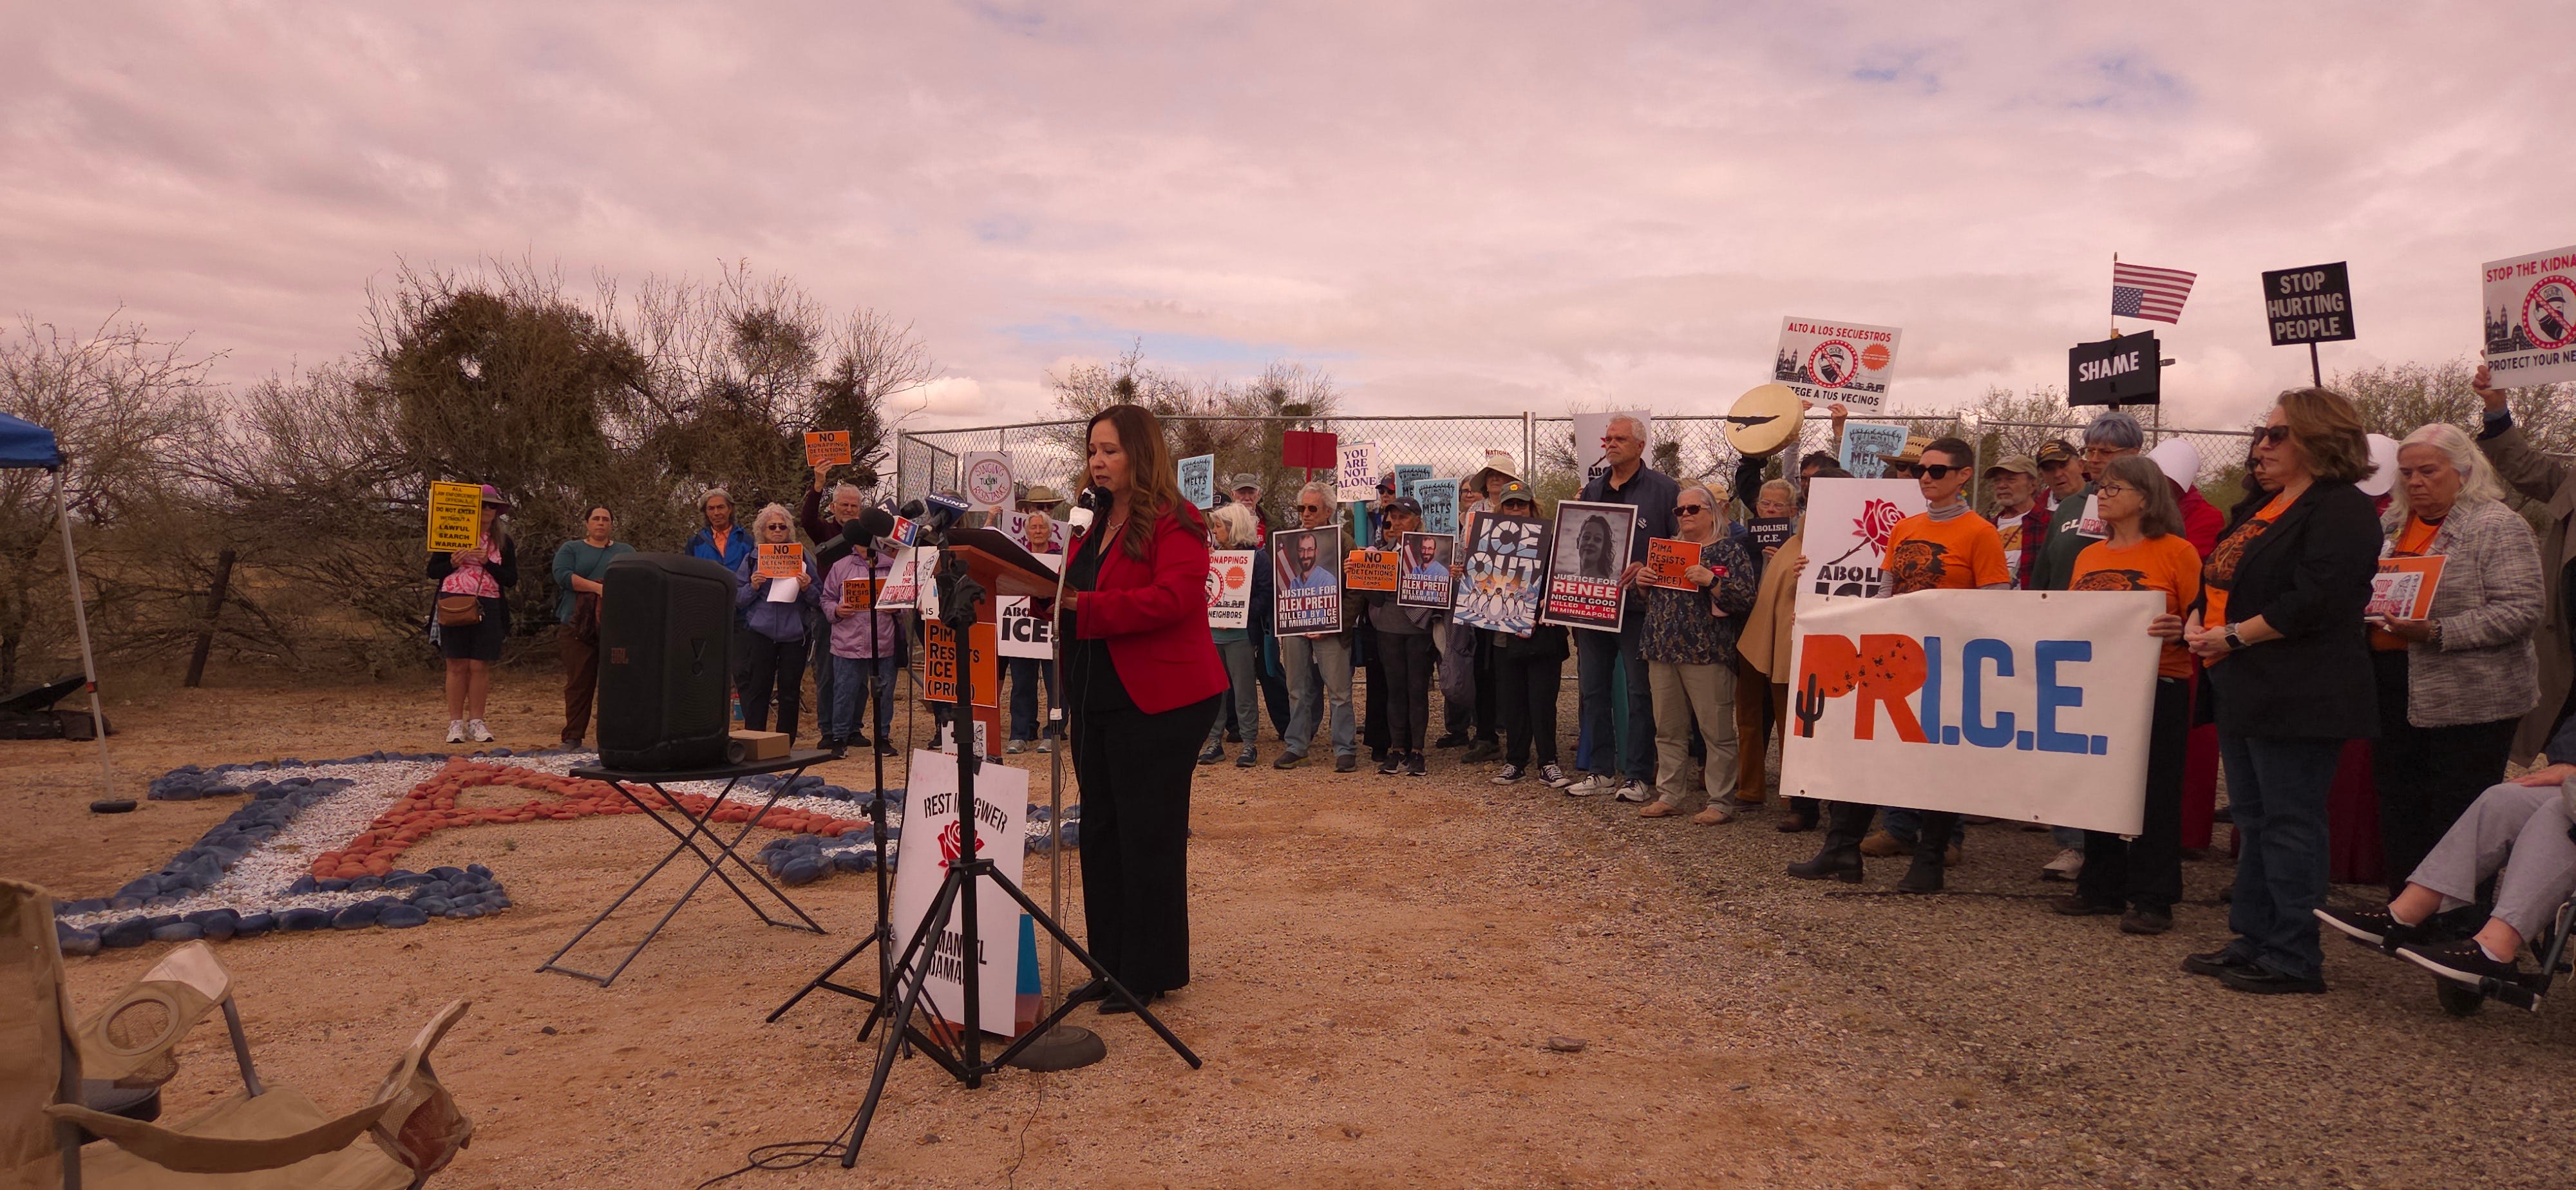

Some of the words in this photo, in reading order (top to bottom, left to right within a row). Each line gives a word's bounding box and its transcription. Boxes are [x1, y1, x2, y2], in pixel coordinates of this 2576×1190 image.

[2486, 266, 2514, 283] STOP
[2515, 261, 2537, 277] THE
[2280, 270, 2325, 294] STOP
[2267, 292, 2345, 319] HURTING
[1788, 323, 1808, 333] ALTO
[1810, 325, 1816, 334] A
[1818, 326, 1834, 336] LOS
[1835, 327, 1892, 343] SECUESTROS
[2275, 316, 2342, 341] PEOPLE
[2078, 351, 2139, 382] SHAME
[2488, 355, 2530, 372] PROTECT
[2533, 352, 2560, 366] YOUR
[1814, 389, 1820, 399] A
[1822, 390, 1839, 401] TUS
[1841, 392, 1880, 406] VECINOS
[819, 433, 835, 442] NO
[1343, 449, 1368, 460] YOU
[1344, 458, 1368, 469] ARE
[968, 464, 1005, 477] SINGING
[1343, 468, 1369, 478] NOT
[1184, 476, 1208, 486] MELTS
[1338, 477, 1376, 488] ALONE
[973, 484, 1008, 501] RESISTANCE
[1422, 502, 1452, 515] MELTS
[1750, 524, 1788, 533] ABOLISH
[1477, 518, 1542, 559] ICE
[1757, 534, 1781, 543] I.C.E.
[773, 545, 790, 554] NO
[1651, 542, 1672, 553] PIMA
[1364, 552, 1382, 563] NO
[1650, 552, 1685, 565] RESISTS
[1352, 569, 1393, 577] DETENTIONS
[1354, 562, 1396, 571] IDNAPPINGS
[1466, 552, 1541, 584] OUT
[1403, 573, 1432, 581] JUSTICE
[1553, 573, 1595, 583] JUSTICE
[1597, 577, 1618, 587] FOR
[1816, 565, 1882, 583] ABOLI
[1278, 587, 1316, 599] JUSTICE
[1318, 585, 1337, 595] FOR
[1402, 580, 1421, 590] ALEX
[1423, 581, 1448, 592] PRETTI
[1553, 581, 1617, 600] RENEE
[2373, 579, 2393, 592] STOP
[1278, 598, 1303, 612] ALEX
[1305, 594, 1337, 610] PRETTI
[1408, 594, 1447, 603] MINNEAPOLIS
[1550, 600, 1578, 609] KILLED
[1551, 593, 1587, 604] NICOLE
[1588, 598, 1616, 607] GOOD
[1208, 610, 1242, 619] NEIGHBORS
[1279, 611, 1307, 620] KILLED
[1323, 608, 1337, 616] ICE
[1559, 607, 1615, 619] MINNEAPOLIS
[1279, 620, 1287, 628] IN
[1289, 616, 1338, 628] MINNEAPOLIS
[929, 625, 956, 644] PIM
[929, 661, 953, 678] ICE
[927, 680, 975, 701] (PRI)
[923, 793, 952, 818] REST
[973, 797, 1008, 835] OWER
[928, 953, 964, 986] DAMA
